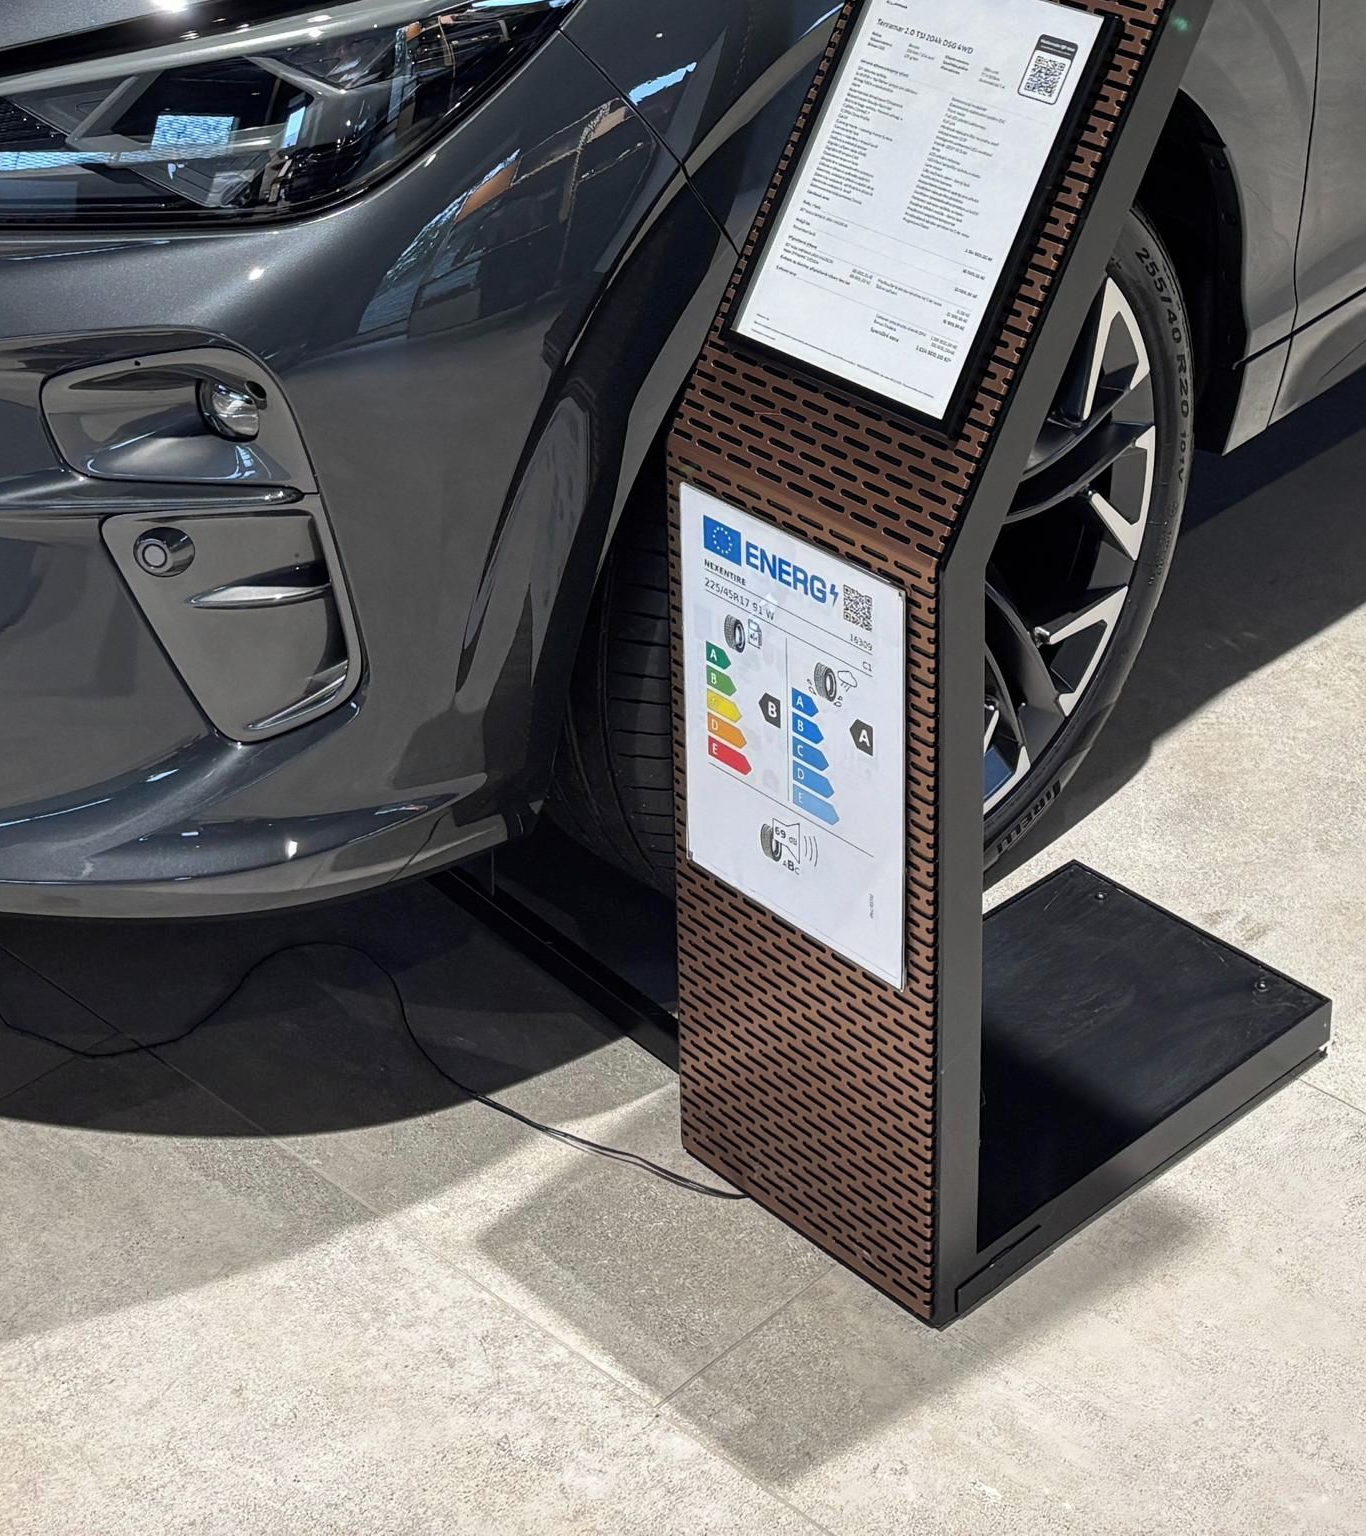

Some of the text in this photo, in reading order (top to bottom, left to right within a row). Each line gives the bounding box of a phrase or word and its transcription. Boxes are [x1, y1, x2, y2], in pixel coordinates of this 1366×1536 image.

[1135, 247, 1182, 344] 255/40
[1176, 354, 1190, 419] R20
[704, 558, 747, 586] NEXENTIRE
[745, 540, 827, 604] ENERG
[704, 577, 775, 621] 225/45R17 91 W
[710, 648, 718, 662] A
[862, 661, 873, 672] C1
[710, 672, 717, 685] B
[796, 696, 804, 709] A
[768, 701, 778, 718] B
[711, 719, 718, 731] D
[797, 719, 804, 732] B
[858, 729, 871, 747] A
[712, 744, 719, 756] E
[797, 745, 804, 757] C
[797, 768, 804, 780] D
[798, 792, 804, 804] E
[774, 826, 786, 839] 69
